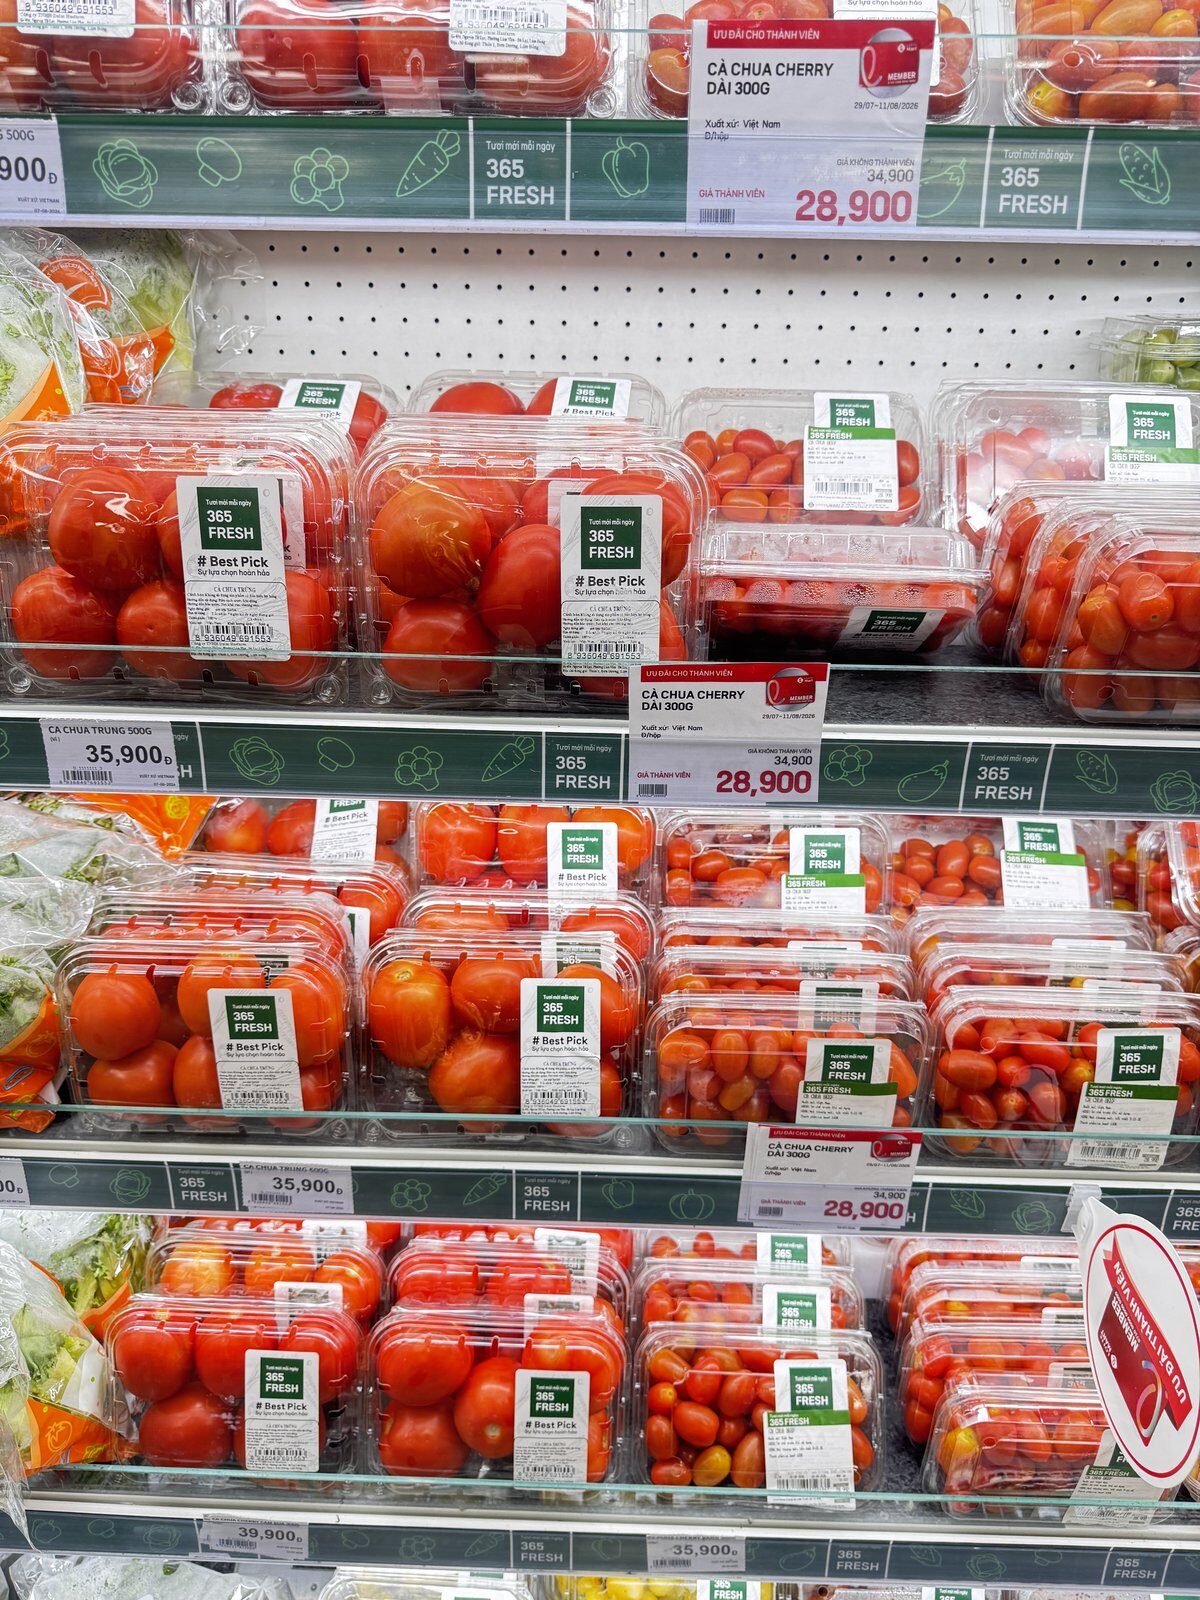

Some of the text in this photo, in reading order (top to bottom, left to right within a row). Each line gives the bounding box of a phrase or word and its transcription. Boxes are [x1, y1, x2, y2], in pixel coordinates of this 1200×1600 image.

[25, 3, 113, 15] 8 936049 691553
[714, 28, 820, 40] ƯU ĐÃI CHO THÀNH VIÊN
[707, 59, 834, 77] CÀ CHUA CHERRY
[888, 72, 916, 81] MEMBER
[707, 78, 770, 95] DÀI 300G
[705, 119, 780, 130] Xuất xứ: Việt Nam
[6, 129, 35, 141] 500G
[486, 140, 555, 153] Tươi mới mỗi ngày
[1004, 148, 1074, 162] Tươi mới mỗi ngày
[837, 157, 915, 167] GIÁ KHÔNG THÀNH VIÊN
[486, 158, 525, 179] 365
[867, 169, 914, 184] 34,900
[1001, 167, 1040, 187] 365
[487, 186, 554, 206] FRESH
[699, 188, 765, 199] GIÁ THÀNH VIÊN
[795, 189, 912, 226] 28,900
[999, 194, 1068, 215] FRESH
[836, 408, 855, 417] 365
[836, 418, 870, 426] FRESH
[1133, 417, 1154, 427] 365
[1133, 429, 1170, 440] FRESH
[207, 510, 232, 522] 365
[208, 527, 254, 540] FRESH
[589, 530, 614, 542] 365
[589, 546, 634, 559] FRESH
[198, 556, 269, 568] # Best Pick
[575, 575, 645, 587] # Best Pick
[646, 668, 733, 678] ƯU ĐÃI CHO THÀNH VIÊN
[642, 687, 746, 700] CÀ CHUA CHERRY
[642, 700, 694, 712] DÀI 300G
[48, 726, 152, 736] CA CHUA TRUNG 500G
[641, 724, 657, 732] Xuất
[86, 745, 172, 766] 35,900Đ
[774, 755, 813, 766] 34,900
[556, 756, 586, 770] 365
[637, 771, 691, 779] GIÁ THÀNH VIÊN
[977, 767, 1010, 781] 365
[556, 774, 611, 790] FRESH
[716, 770, 812, 797] 28,900
[975, 785, 1033, 801] FRESH
[1023, 832, 1042, 841] 365
[567, 844, 585, 853] 365
[1024, 842, 1057, 851] FRESH
[809, 849, 828, 858] 365
[567, 855, 599, 864] FRESH
[809, 860, 841, 869] FRESH
[567, 873, 586, 881] Best
[588, 873, 606, 881] Pick
[543, 1003, 563, 1012] 365
[233, 1012, 255, 1021] 365
[543, 1015, 579, 1025] FRESH
[234, 1023, 273, 1033] FRESH
[533, 1036, 588, 1045] # Best Pick
[226, 1043, 284, 1051] # Best Pick
[1120, 1053, 1141, 1063] 365
[829, 1061, 850, 1069] 365
[1119, 1064, 1155, 1074] FRESH
[828, 1072, 865, 1080] FRESH
[1105, 1089, 1133, 1097] FRESH
[768, 1142, 854, 1153] CÀ CHUA CHERRY
[768, 1150, 810, 1159] DÀI 300G
[179, 1177, 206, 1188] 365
[524, 1186, 550, 1197] 365
[873, 1191, 905, 1200] 34,900
[182, 1191, 227, 1203] FRESH
[524, 1200, 570, 1212] FRESH
[824, 1200, 904, 1221] 28,900
[775, 1249, 792, 1259] 365
[782, 1307, 800, 1317] 365
[1111, 1296, 1139, 1352] MEMBER
[1114, 1261, 1188, 1403] ƯU ĐÃI THÀNH VIÊN
[266, 1373, 284, 1381] 365
[266, 1384, 299, 1393] FRESH
[795, 1384, 814, 1394] 365
[536, 1392, 555, 1401] 365
[796, 1396, 829, 1406] FRESH
[288, 1403, 307, 1411] Pick
[536, 1402, 569, 1412] FRESH
[557, 1421, 577, 1429] Pick
[769, 1417, 810, 1426] 365 FRESH
[521, 1541, 544, 1551] 365
[521, 1553, 563, 1562] FRESH
[838, 1550, 861, 1559] 365
[836, 1561, 879, 1571] FRESH
[1116, 1558, 1140, 1568] 365
[1113, 1569, 1157, 1580] FRESH
